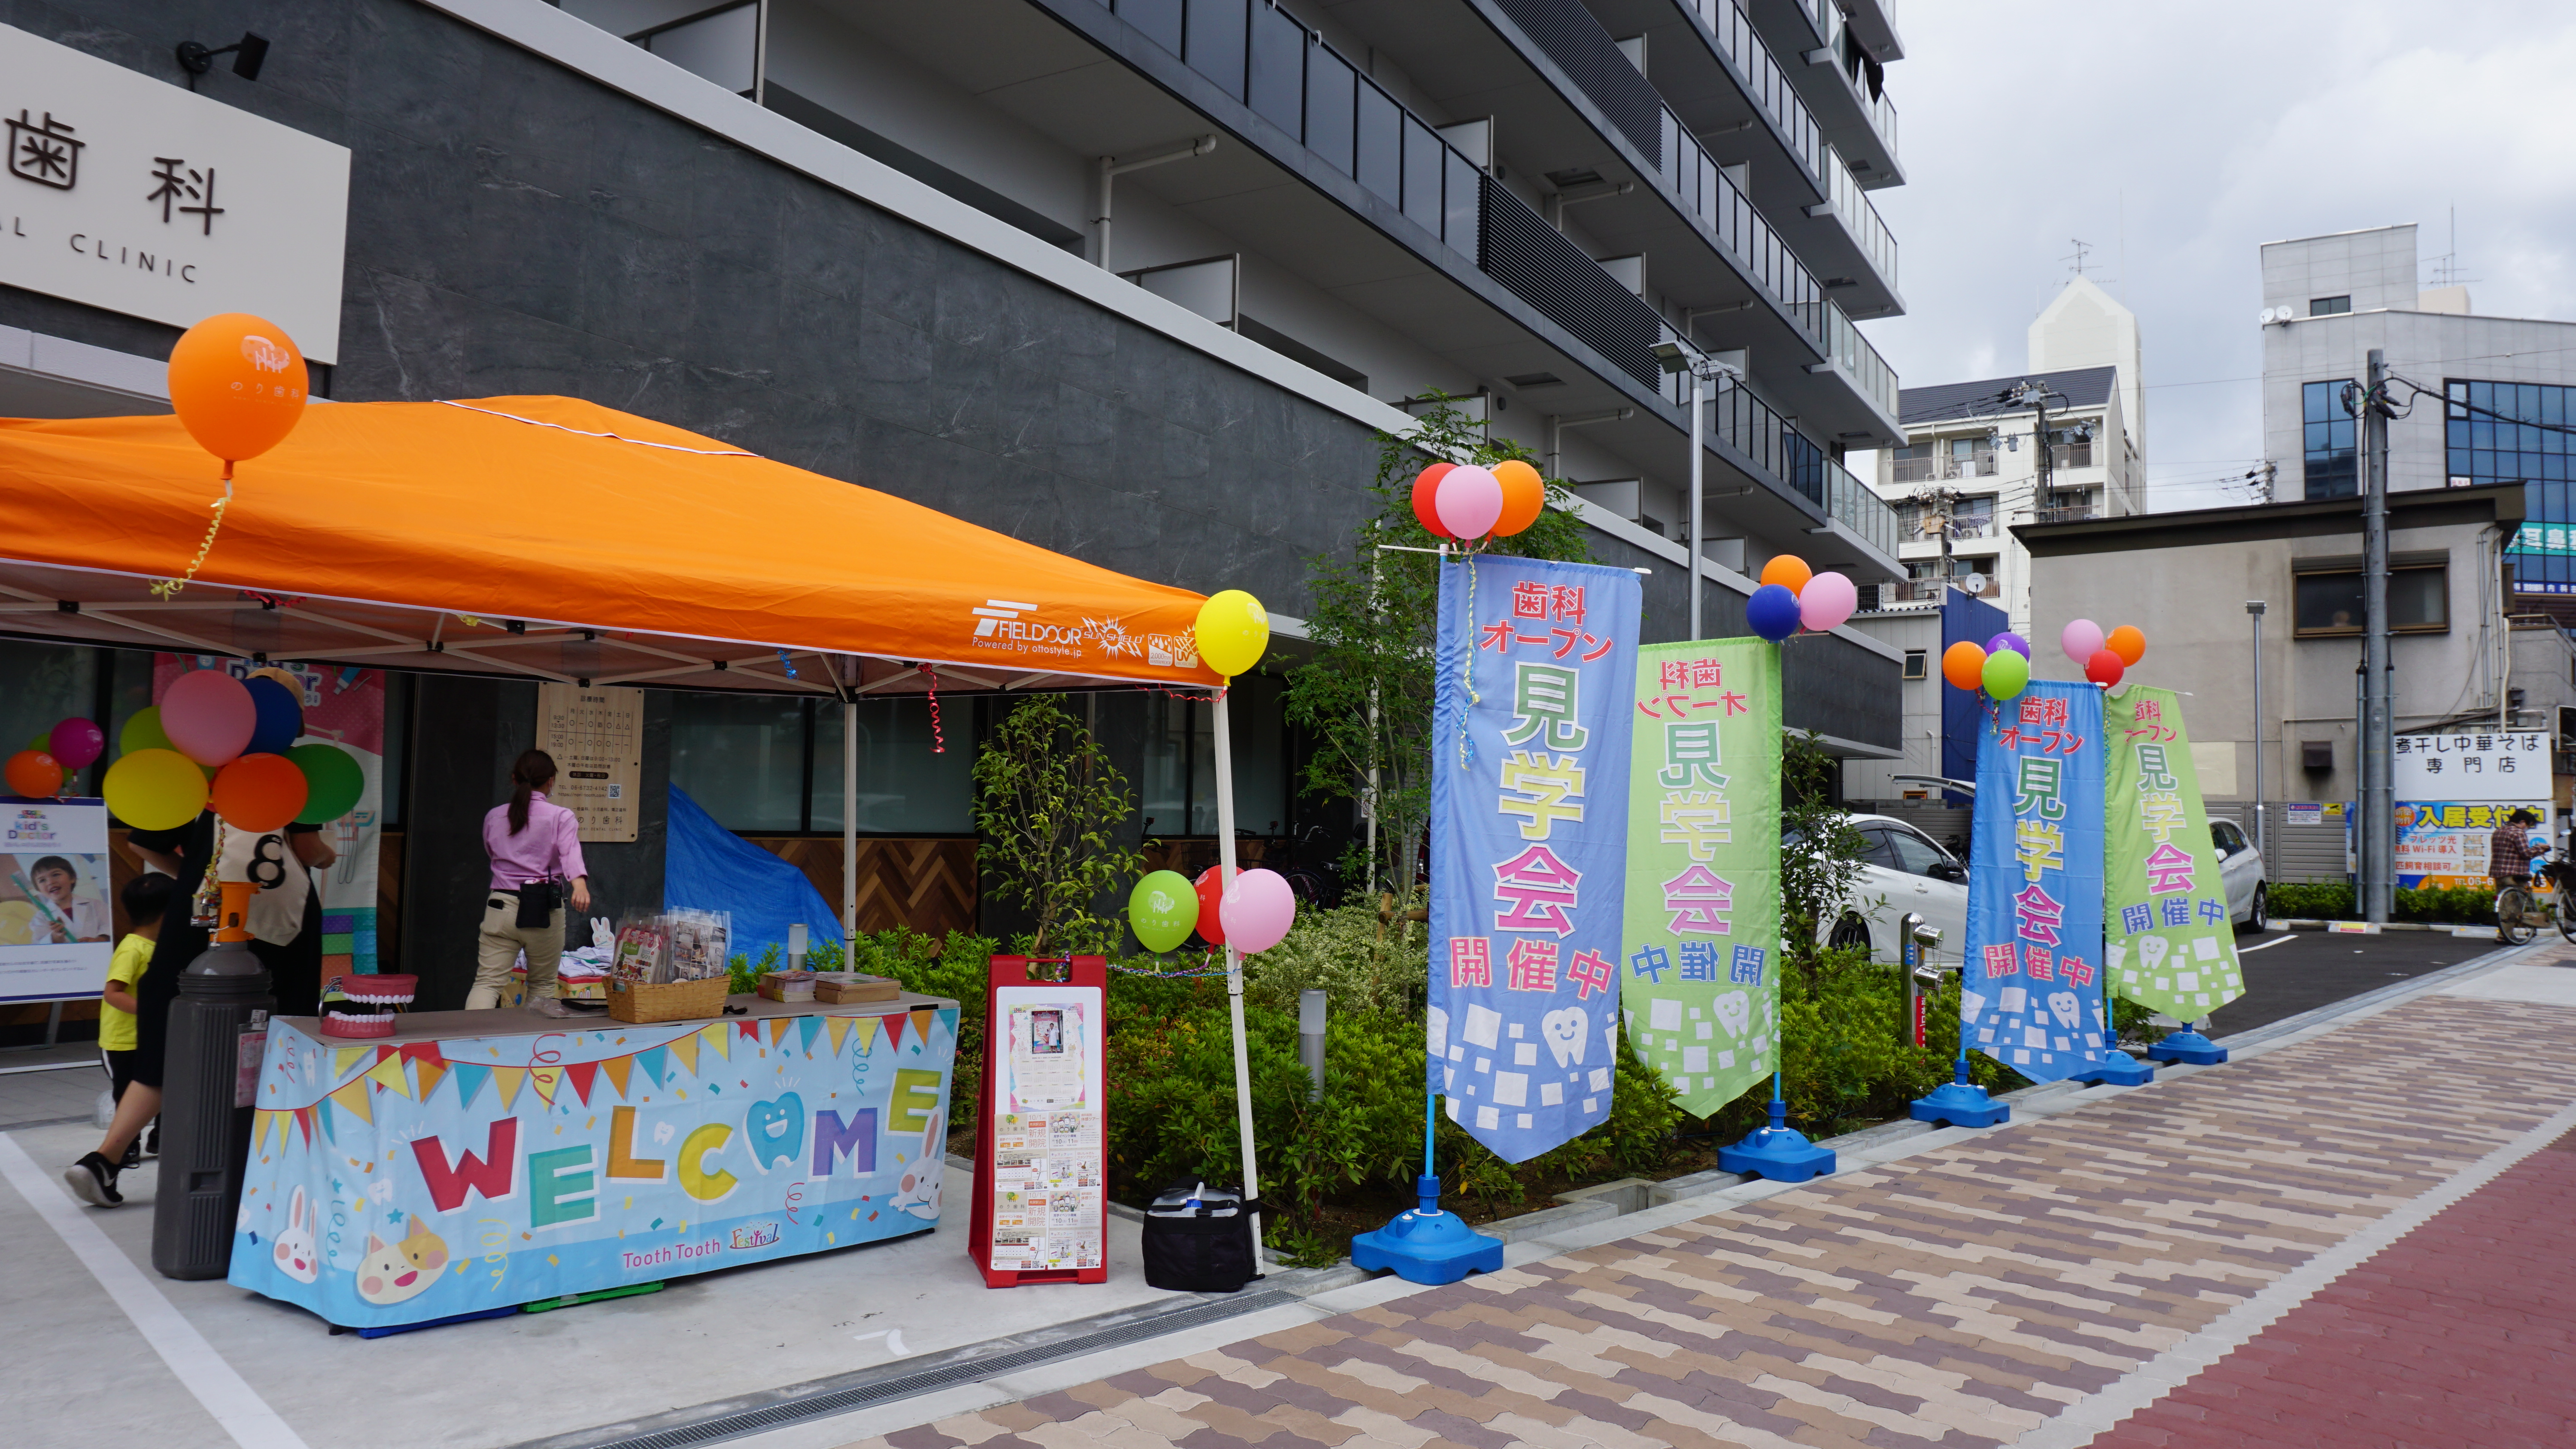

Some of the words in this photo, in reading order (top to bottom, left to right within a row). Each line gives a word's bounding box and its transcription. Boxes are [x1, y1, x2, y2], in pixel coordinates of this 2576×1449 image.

[4, 109, 225, 236] 歯科
[70, 233, 197, 284] CLINIC
[231, 382, 299, 400] のり歯科
[1511, 580, 1587, 627] 歯科
[999, 620, 1081, 646] FIELDOOR
[1083, 631, 1106, 640] SUN
[1106, 633, 1142, 644] SHIELD
[1479, 618, 1614, 664] オープン
[972, 637, 1013, 650] Powered
[1018, 641, 1028, 654] by
[1032, 645, 1081, 659] ottostyle.jp
[1176, 650, 1191, 661] UV
[2019, 696, 2069, 728] 歯科
[1999, 726, 2085, 755] オープン
[2395, 734, 2539, 754] 煮干し中華そば
[2427, 756, 2516, 774] 専門店
[1491, 660, 1589, 940] 見学会
[578, 816, 623, 825] のり歯科
[2136, 743, 2197, 896] 見学会
[8, 830, 56, 839] Doctor
[2410, 836, 2457, 844] フレッツ光
[2012, 755, 2067, 949] 見学会
[2413, 846, 2435, 854] Wi-Fi
[2438, 846, 2457, 854] 導入
[1141, 918, 1180, 927] のり歯科
[2120, 897, 2225, 937] 開催中
[1449, 936, 1614, 1001] 開催中
[1983, 941, 2096, 990] 開催中
[1029, 1128, 1046, 1138] 新規
[1029, 1139, 1046, 1148] 開院
[1028, 1207, 1046, 1216] 新規
[1028, 1217, 1045, 1226] 開院
[623, 1248, 671, 1268] Tooth
[675, 1239, 720, 1259] Tooth
[732, 1223, 778, 1248] Festival
